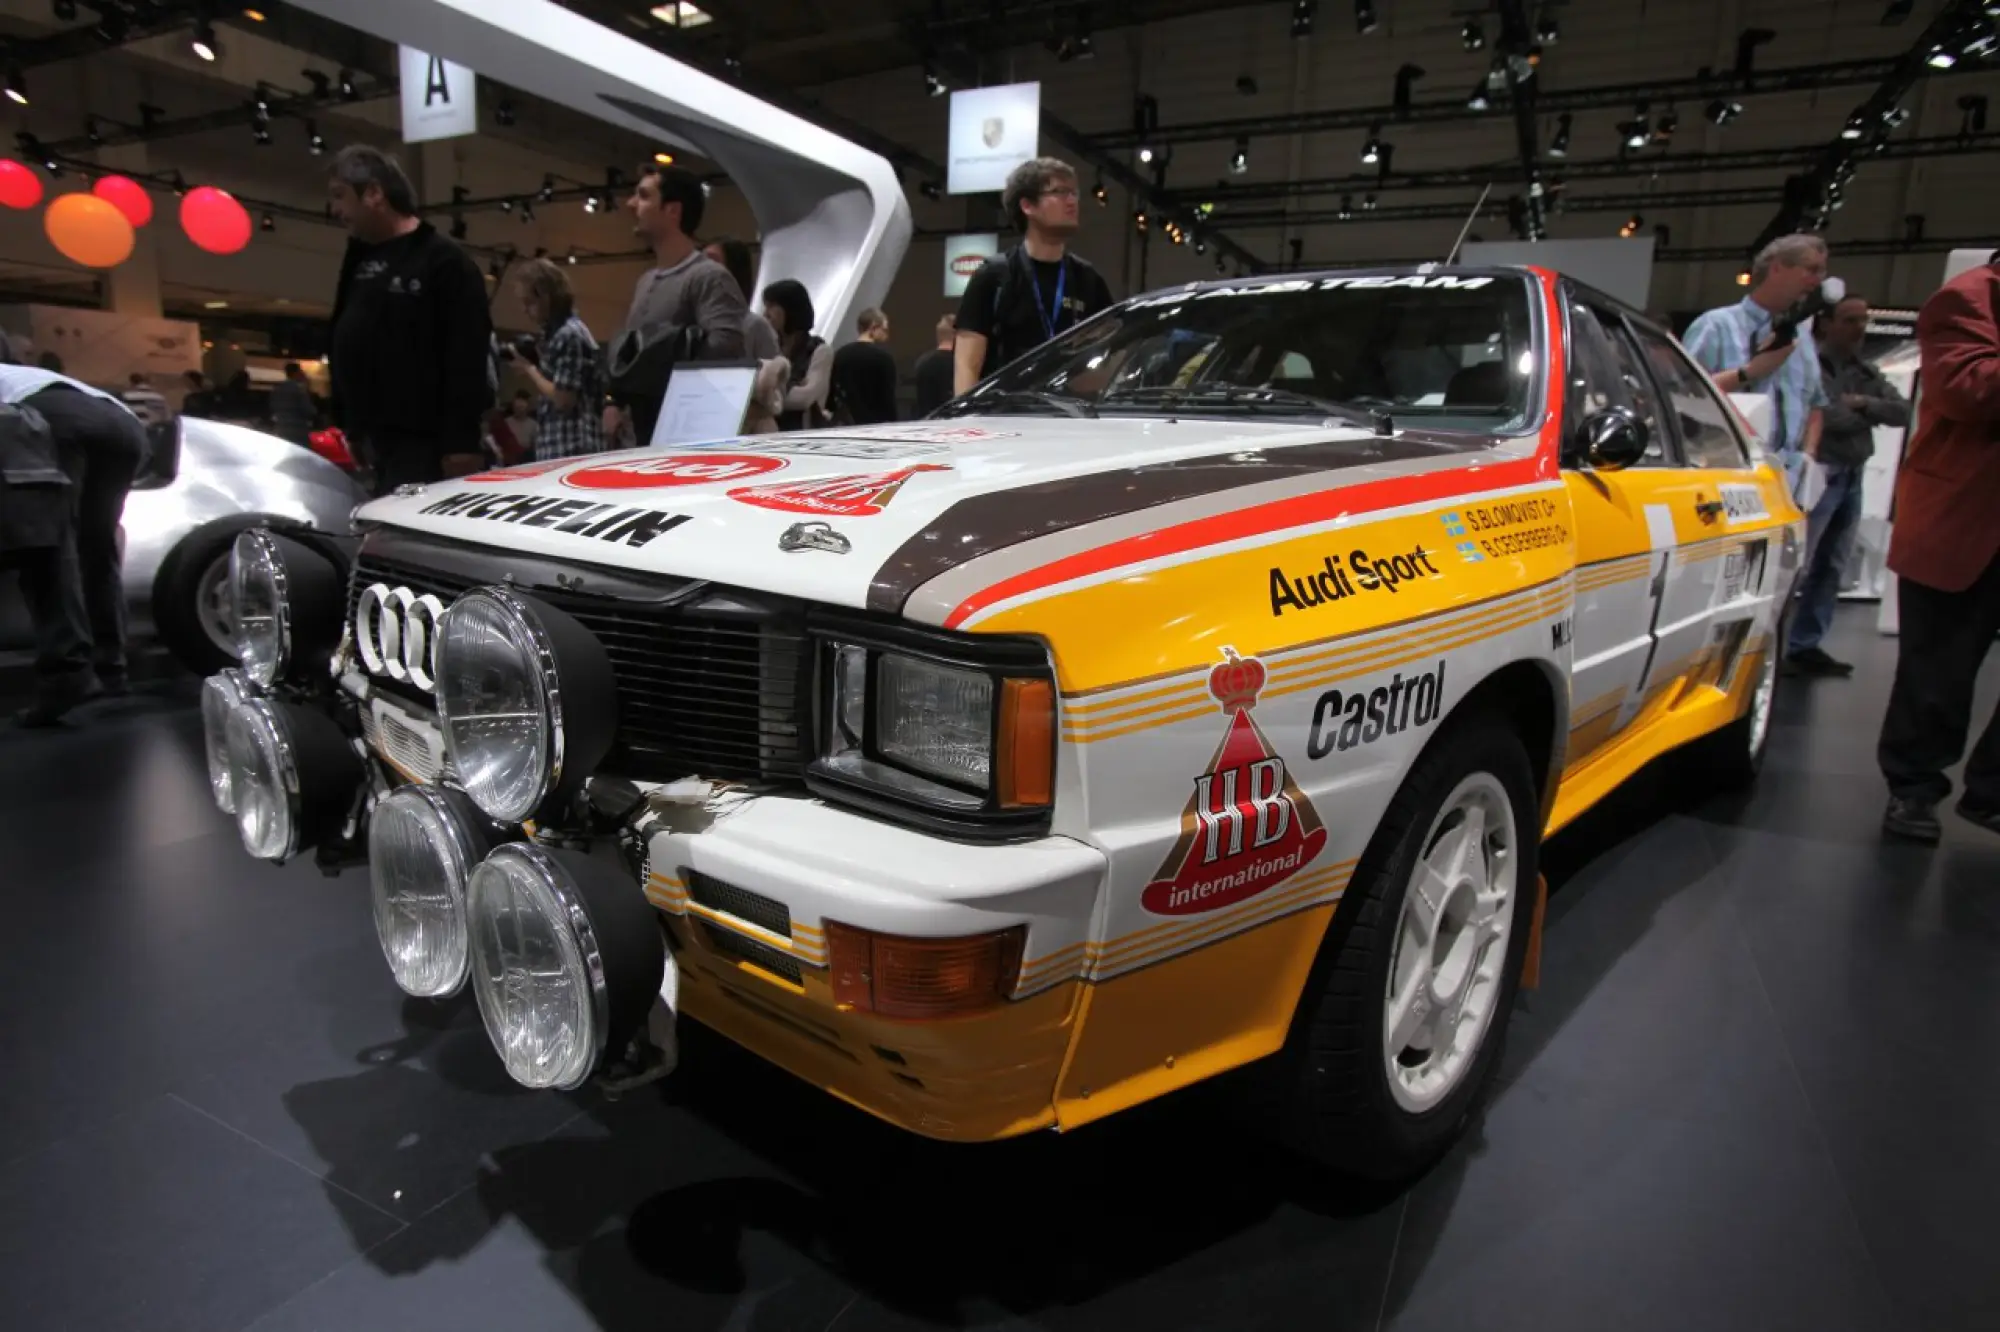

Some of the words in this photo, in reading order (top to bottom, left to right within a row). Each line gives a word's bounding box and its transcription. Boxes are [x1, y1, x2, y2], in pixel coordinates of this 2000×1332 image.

[1319, 276, 1494, 290] TEAM
[418, 493, 694, 548] MICHELIN
[1269, 555, 1356, 617] Audi
[1349, 544, 1440, 593] Sport
[1307, 659, 1446, 760] Castrol
[1194, 756, 1291, 866] HB
[1168, 844, 1305, 909] international
